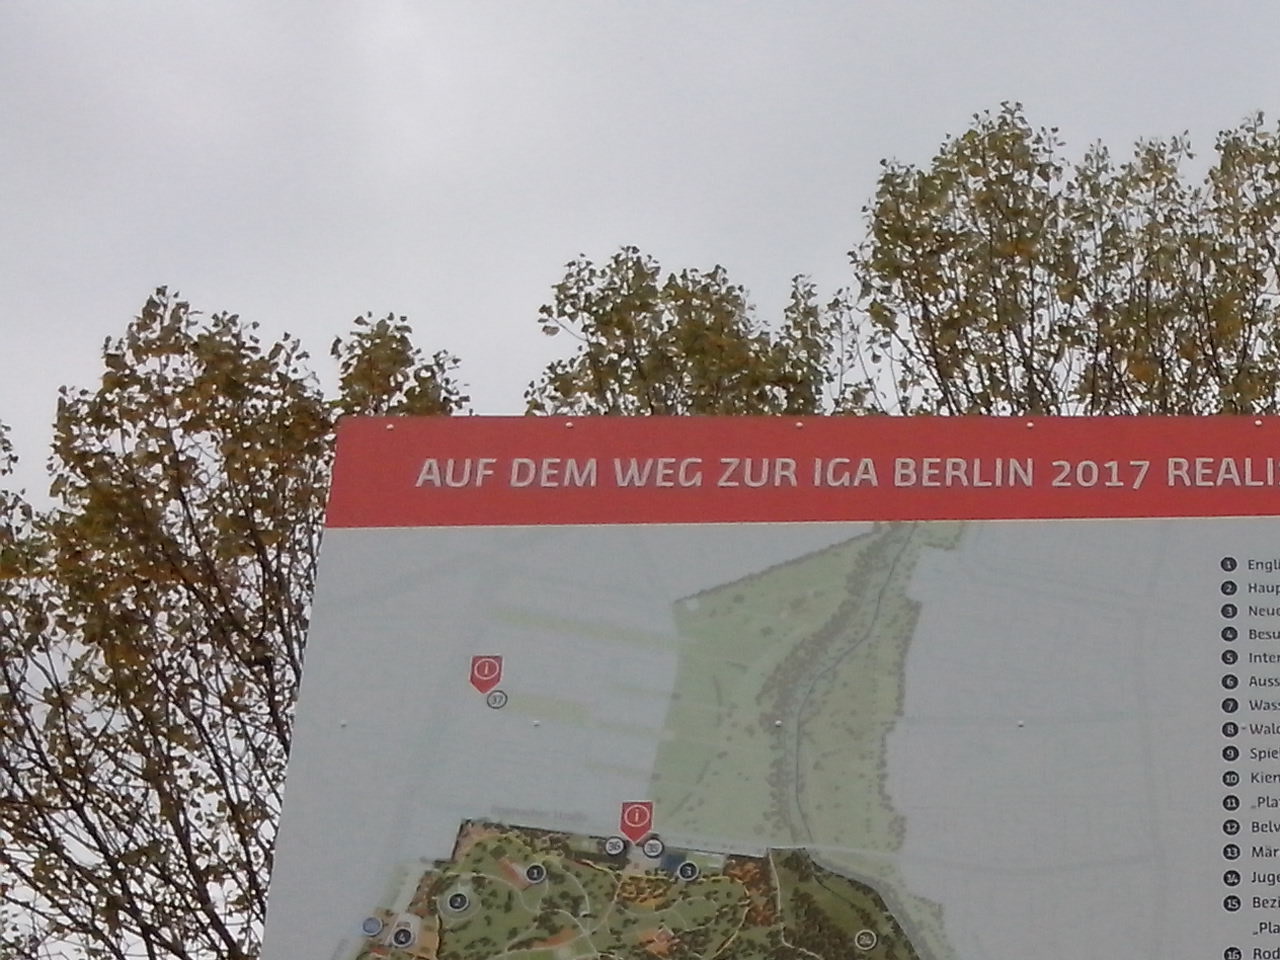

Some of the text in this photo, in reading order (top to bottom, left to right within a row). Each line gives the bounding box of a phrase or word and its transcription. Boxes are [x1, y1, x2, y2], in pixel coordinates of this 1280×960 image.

[414, 457, 498, 488] AUF
[509, 457, 597, 488] DEM
[613, 456, 703, 488] WEG
[716, 457, 798, 488] ZUR
[813, 457, 879, 487] IGA
[893, 457, 1034, 487] BERLIN
[1051, 459, 1151, 490] 2017
